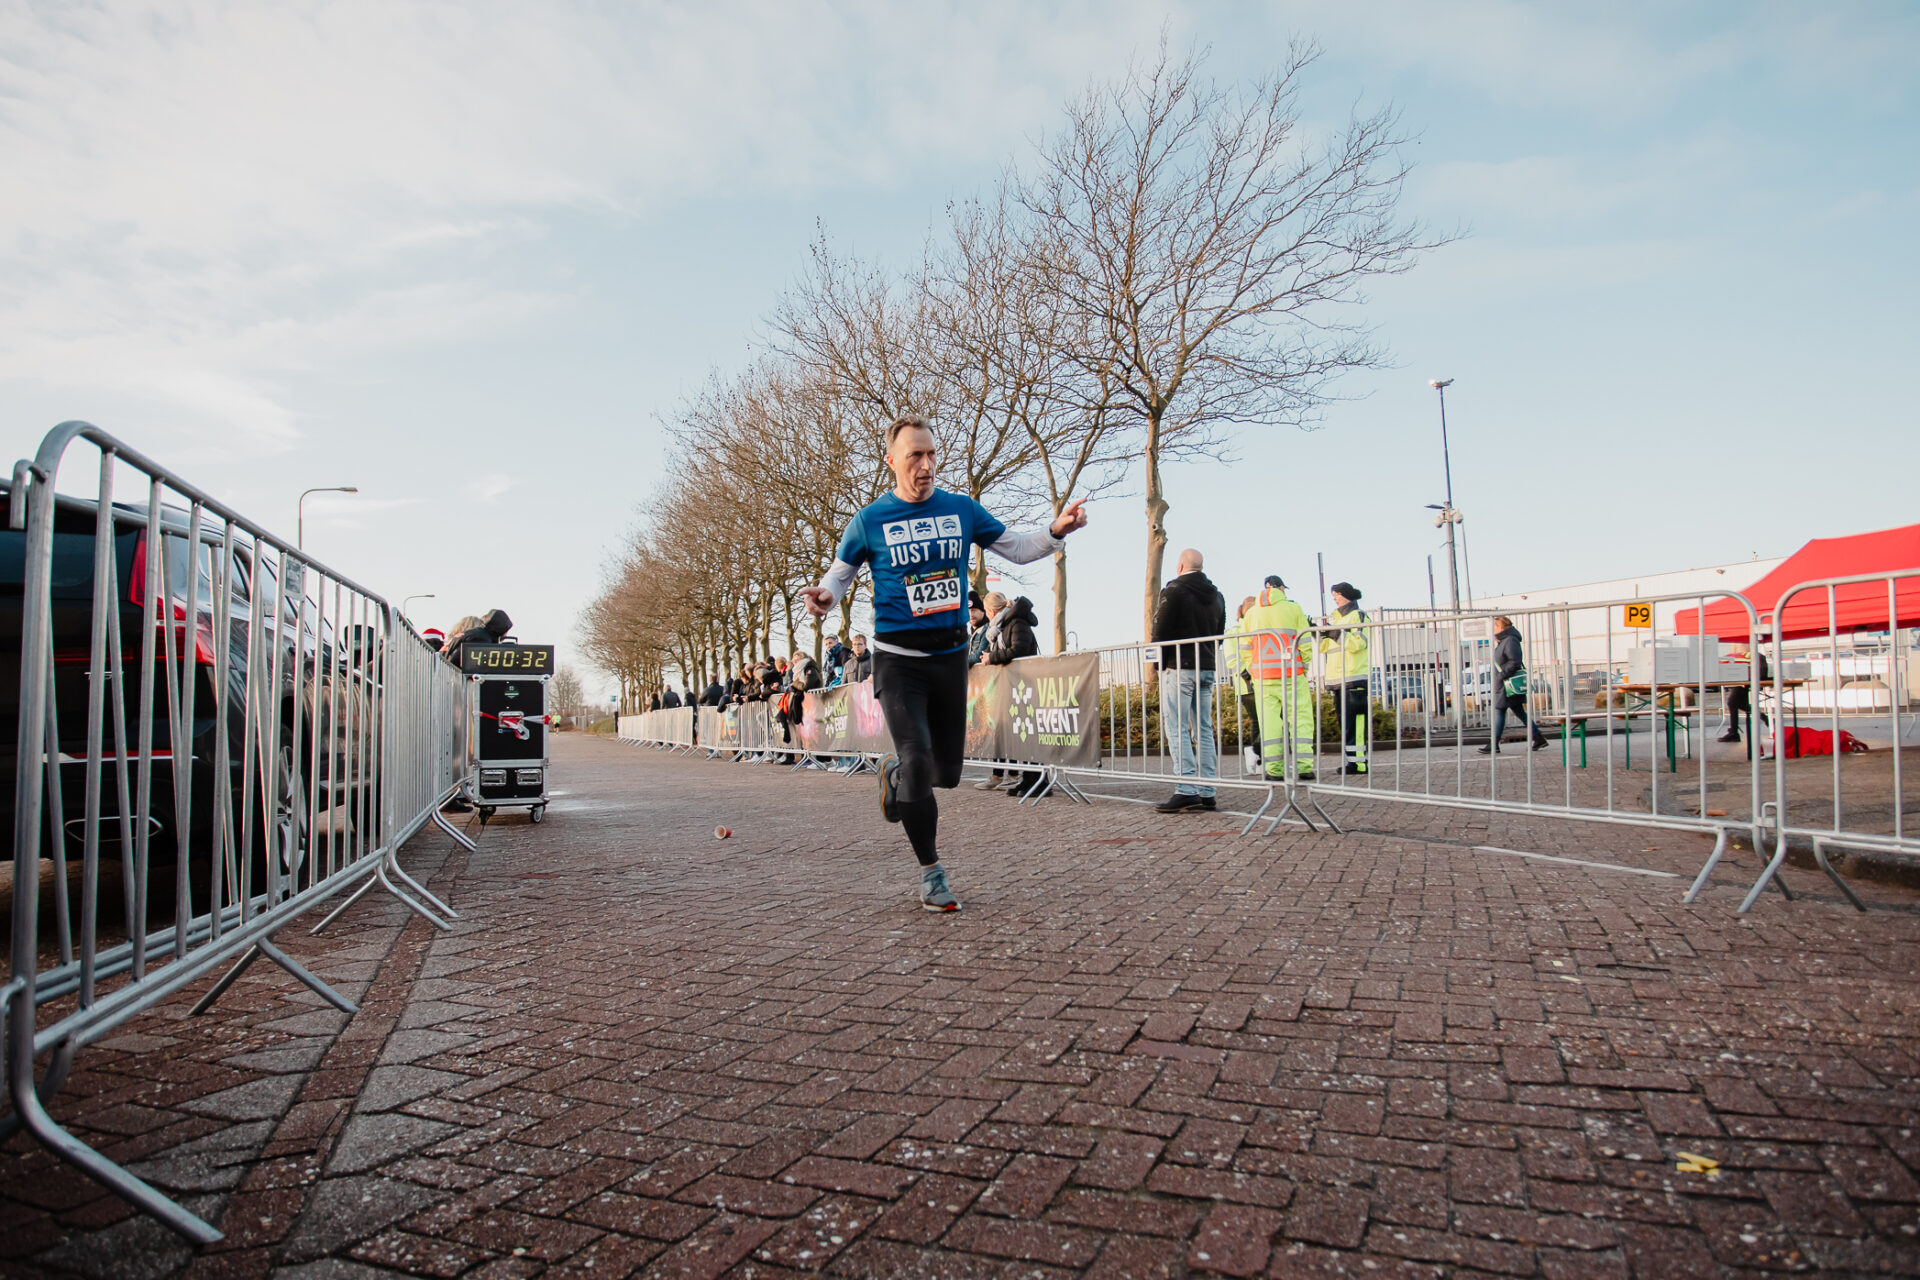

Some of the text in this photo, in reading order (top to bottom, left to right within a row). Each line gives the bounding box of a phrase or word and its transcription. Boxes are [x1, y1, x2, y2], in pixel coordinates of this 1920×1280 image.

[890, 538, 963, 567] JUST TRI
[913, 580, 959, 603] 4239
[1628, 606, 1650, 623] P9
[470, 650, 548, 668] 4:00:32
[1036, 675, 1080, 708] VALK
[1035, 707, 1080, 734] EVENT
[1038, 733, 1080, 747] PRODUCTIONS
